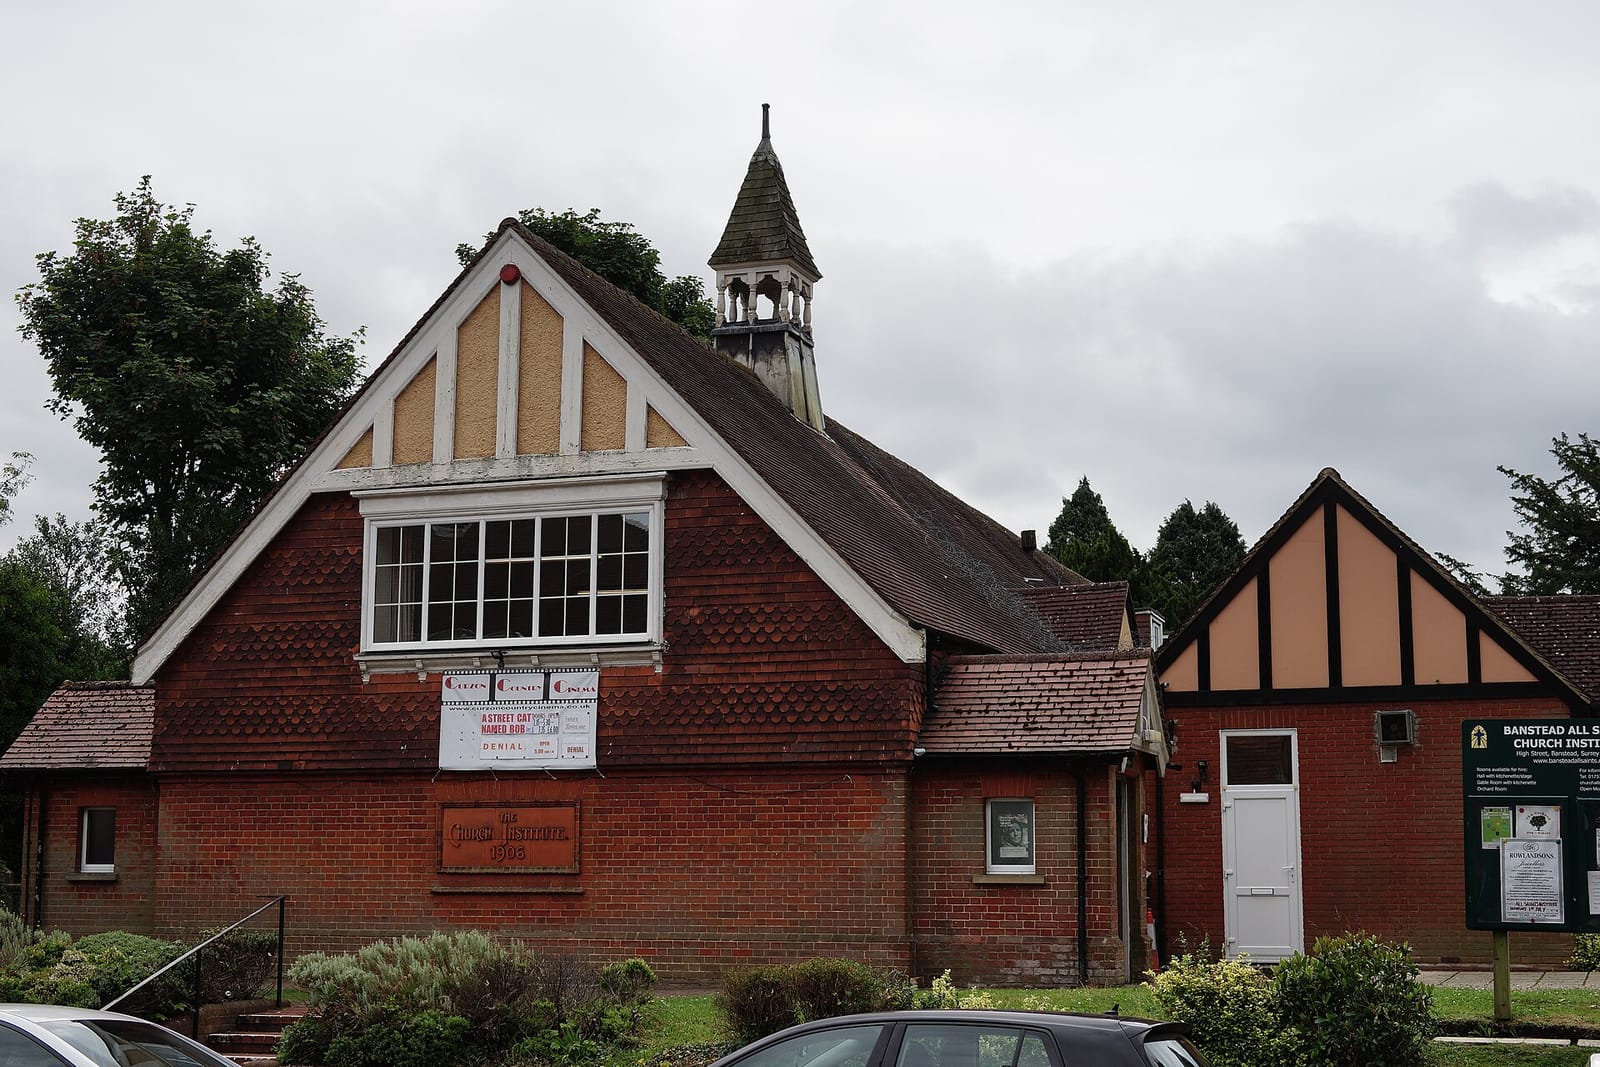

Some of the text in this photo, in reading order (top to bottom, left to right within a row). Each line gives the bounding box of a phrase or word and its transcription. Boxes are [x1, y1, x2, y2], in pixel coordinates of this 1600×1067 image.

[444, 677, 597, 693] CURZON COUNTRY CINEMA
[481, 713, 531, 722] A STREET CAT
[481, 725, 507, 734] NAMED
[509, 725, 526, 733] BOB
[1503, 725, 1565, 736] BANSTEAD
[1568, 725, 1590, 736] ALL
[1513, 738, 1563, 749] CHURCH
[1516, 750, 1530, 758] High
[1551, 750, 1579, 758] Banstead,
[1580, 750, 1600, 758] Surrey
[500, 812, 518, 822] THE
[449, 823, 492, 848] CHURCH
[491, 846, 526, 862] 1906
